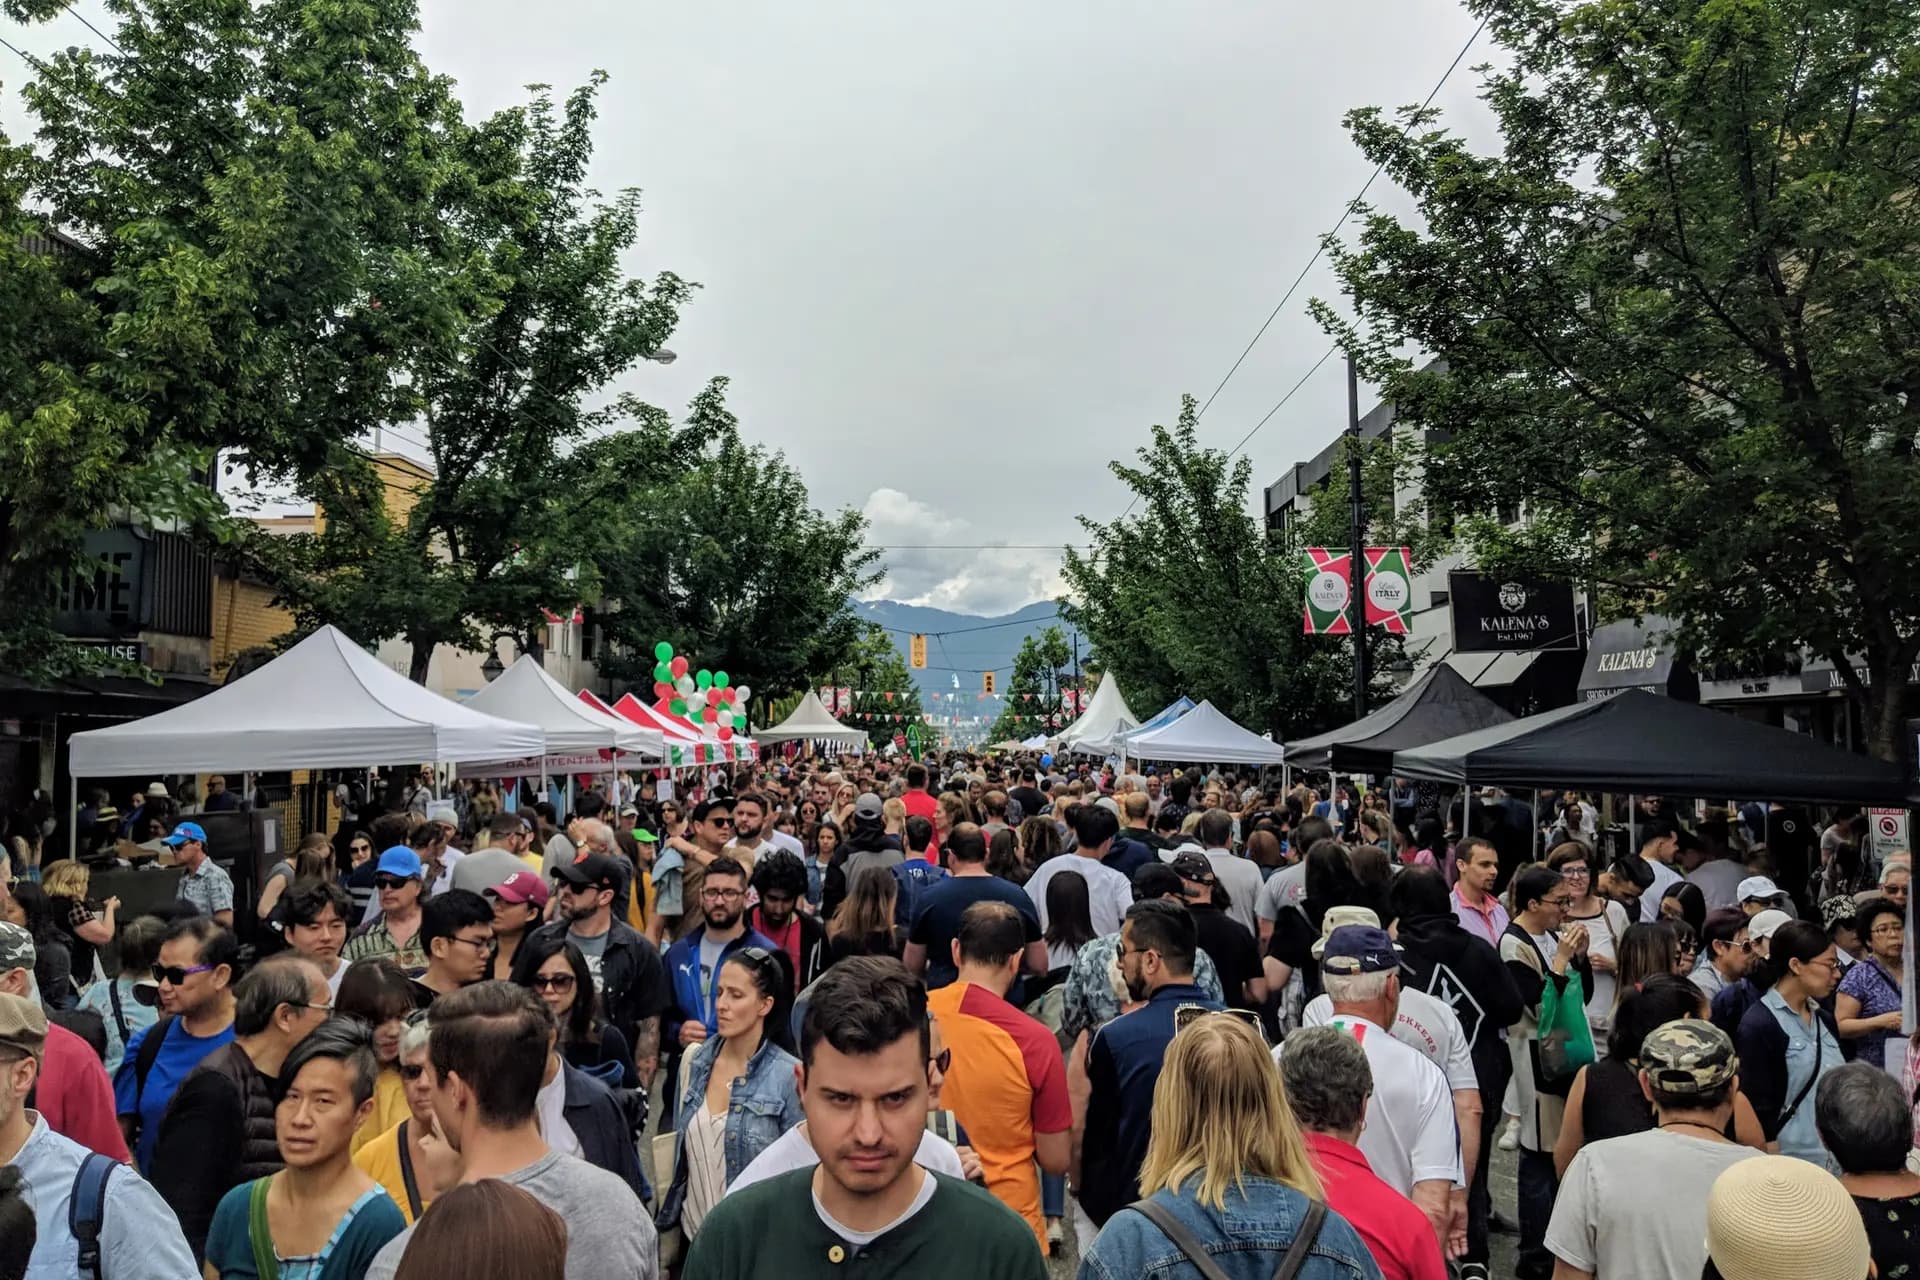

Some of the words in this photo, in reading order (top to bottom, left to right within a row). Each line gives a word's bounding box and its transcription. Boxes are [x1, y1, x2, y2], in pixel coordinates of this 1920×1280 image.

[1375, 590, 1400, 598] ITALY
[1480, 615, 1549, 631] KALENA'S
[1597, 647, 1657, 672] KALENA'S
